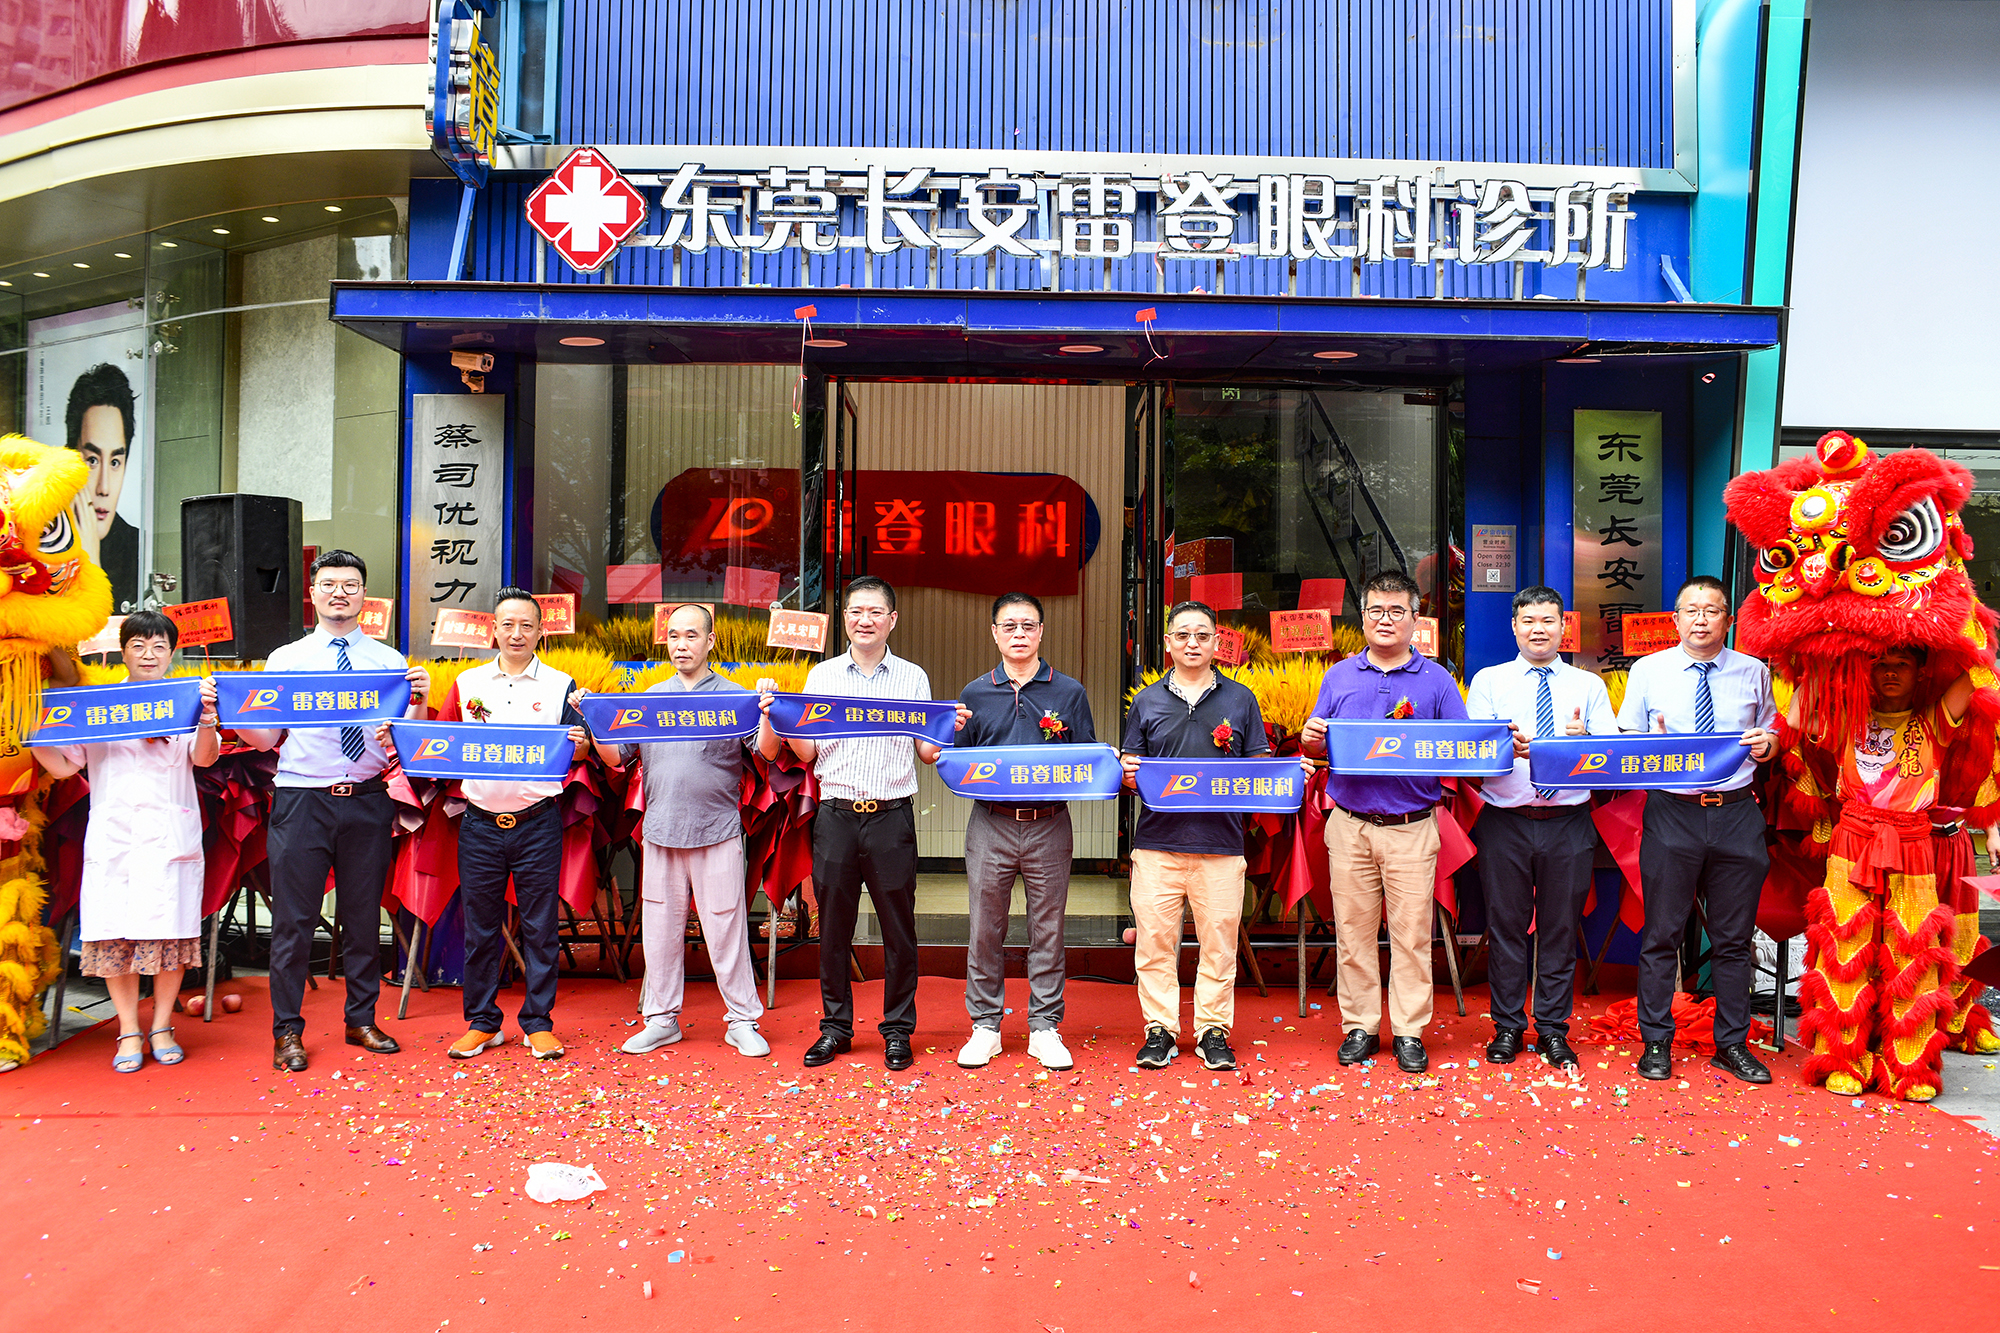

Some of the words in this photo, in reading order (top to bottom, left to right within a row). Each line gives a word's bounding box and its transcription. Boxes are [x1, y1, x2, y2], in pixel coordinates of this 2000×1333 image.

[654, 162, 1636, 271] 东莞长安雷登眼科诊所
[429, 422, 483, 664] 蔡司优视力
[293, 690, 379, 711] 雷登眼科
[86, 699, 174, 726] 雷登眼科
[656, 709, 738, 727] 雷登眼科
[844, 706, 928, 727] 雷登眼科
[462, 743, 546, 765] 雷登眼科
[1414, 739, 1498, 761] 雷登眼科
[1897, 719, 1924, 779] 飛龍
[1010, 763, 1094, 785] 雷登眼科
[1620, 752, 1705, 775] 雷登眼科
[1210, 777, 1294, 798] 雷登眼科
